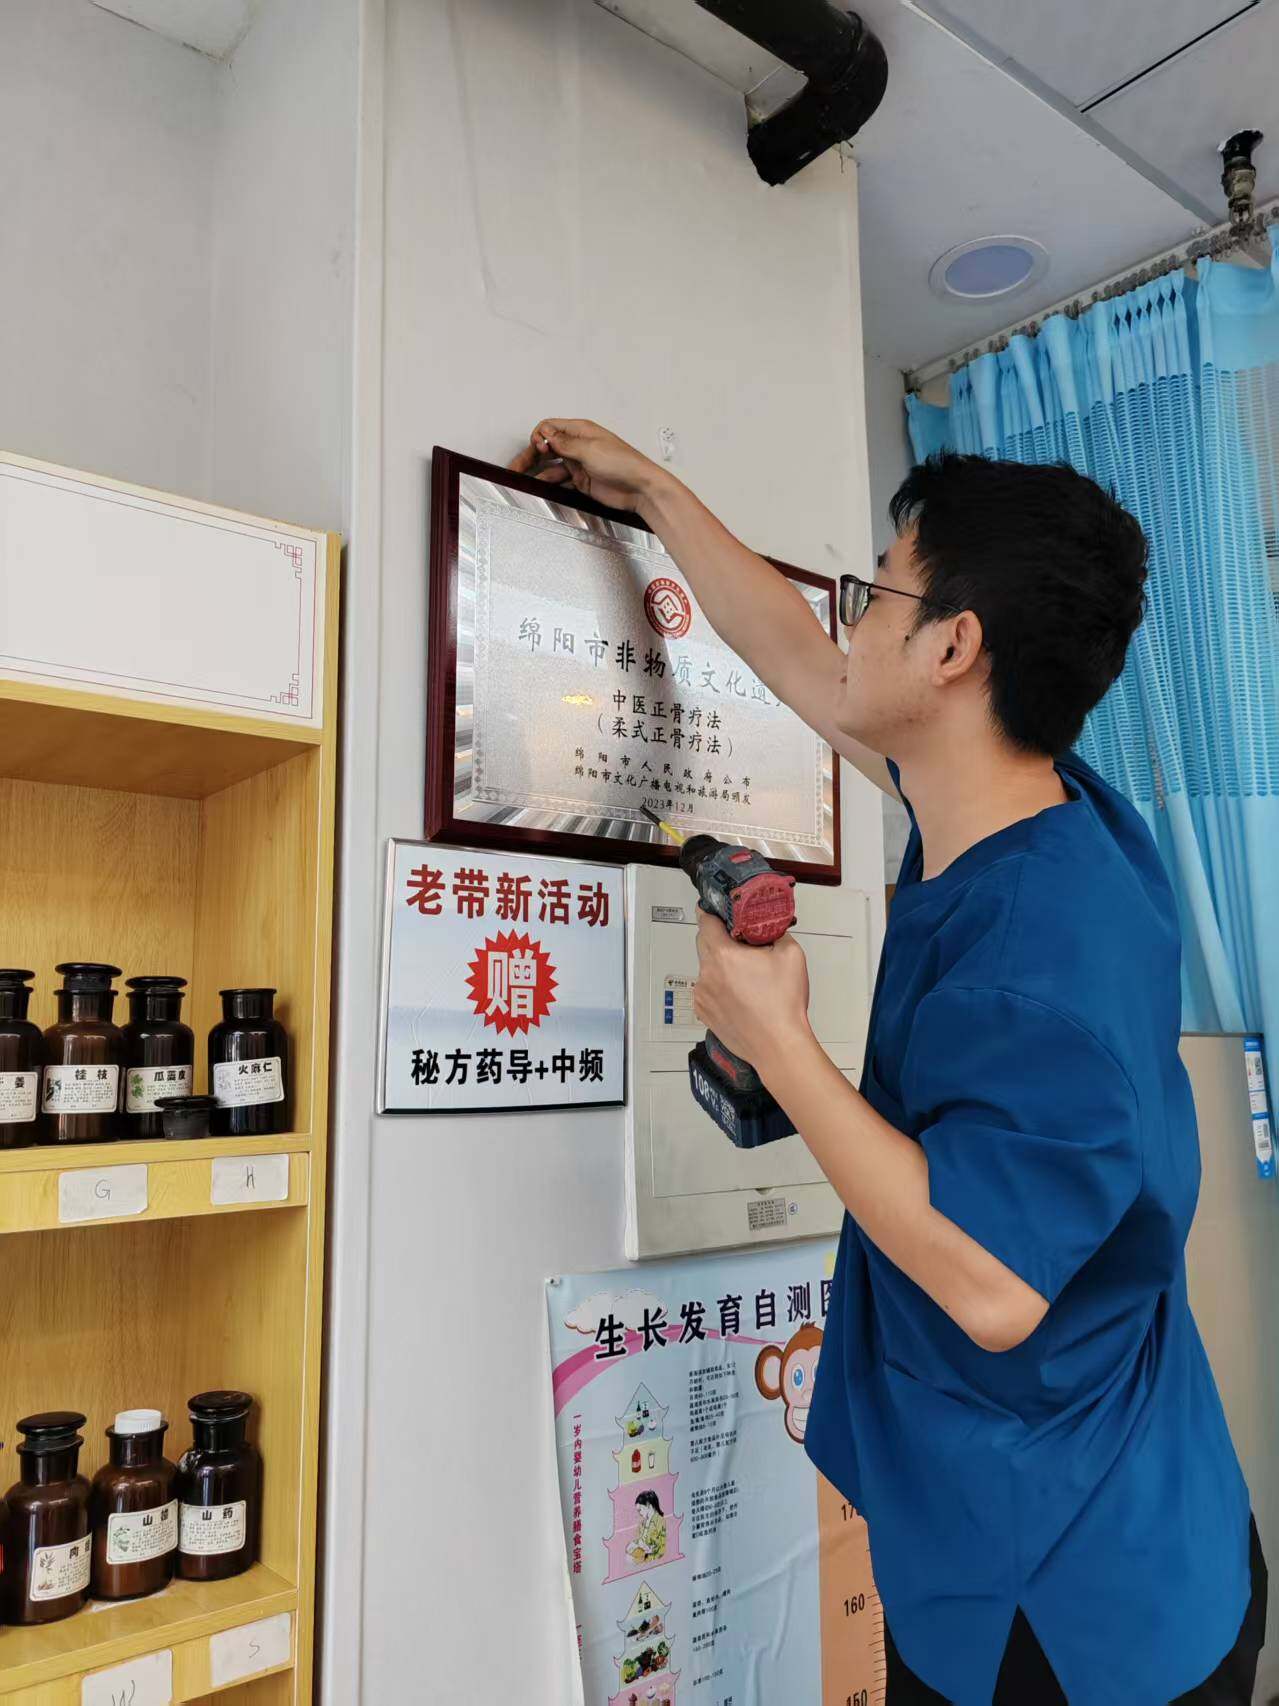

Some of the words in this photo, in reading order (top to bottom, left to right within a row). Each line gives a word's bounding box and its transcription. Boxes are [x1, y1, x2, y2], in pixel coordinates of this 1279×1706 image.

[517, 617, 781, 708] 绵阳市非物质文化遗
[612, 689, 722, 730] 中医正骨疗法
[575, 747, 751, 790] 绵阳市人民政府公布
[641, 797, 695, 814] 2023年12月
[406, 864, 610, 928] 老带新活动
[487, 948, 538, 1019] 赠
[75, 1069, 108, 1080] 桂枝
[238, 1062, 273, 1075] 火麻仁
[411, 1047, 604, 1086] 秘方药导+中频
[95, 1179, 110, 1200] G
[202, 1507, 233, 1521] 山药
[843, 1593, 866, 1617] 160
[249, 1639, 261, 1658] S
